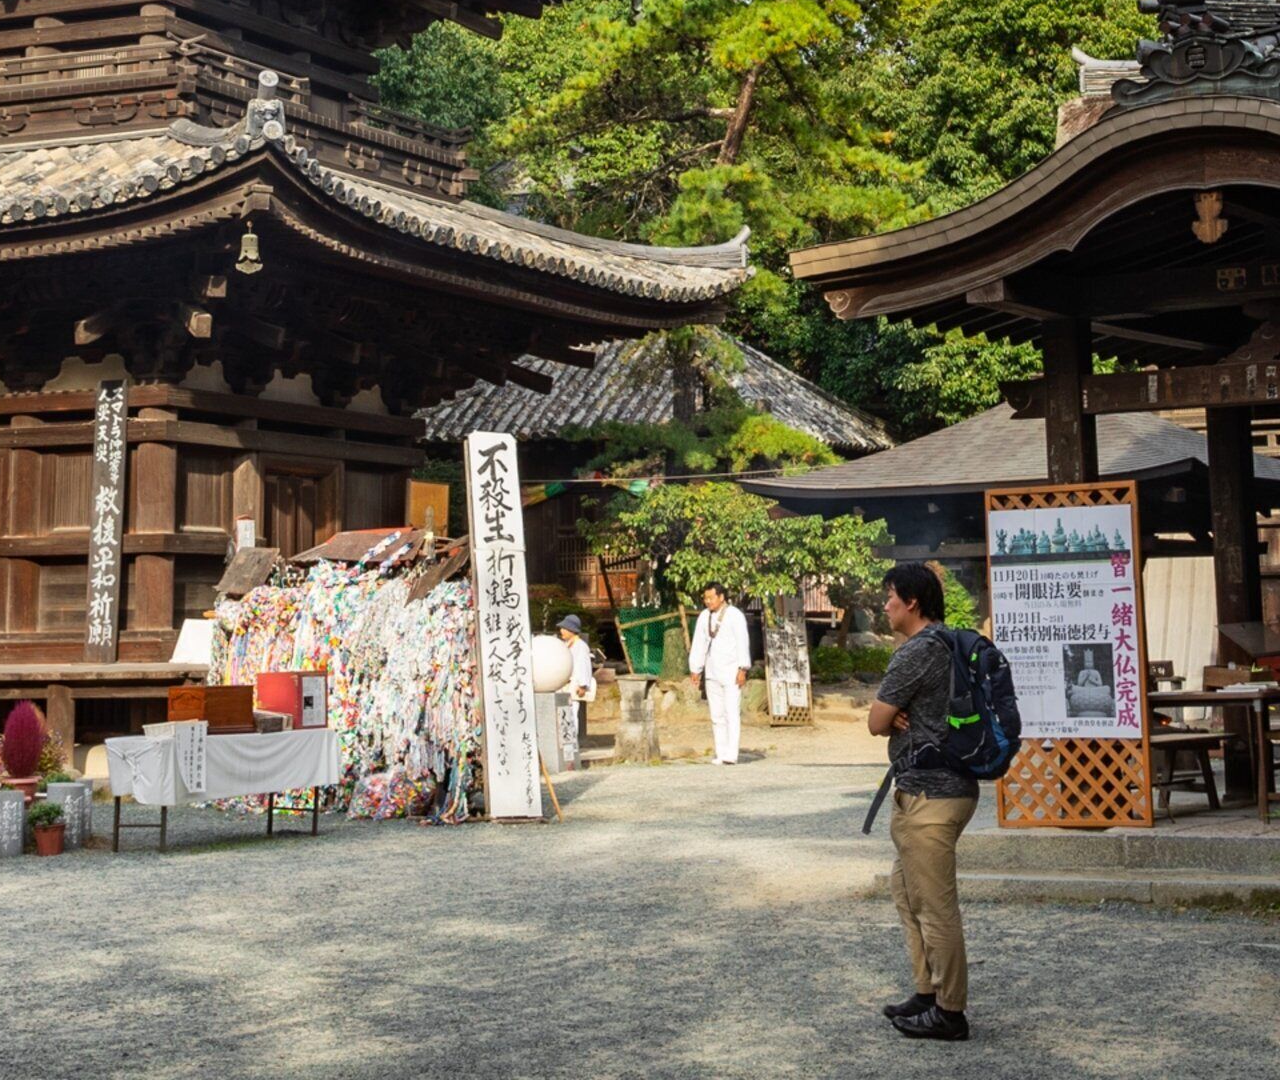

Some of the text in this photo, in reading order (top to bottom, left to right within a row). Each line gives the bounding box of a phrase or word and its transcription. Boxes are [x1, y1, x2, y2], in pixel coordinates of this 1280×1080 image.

[477, 441, 515, 544] 不殺生
[1015, 581, 1082, 601] 開眼法要
